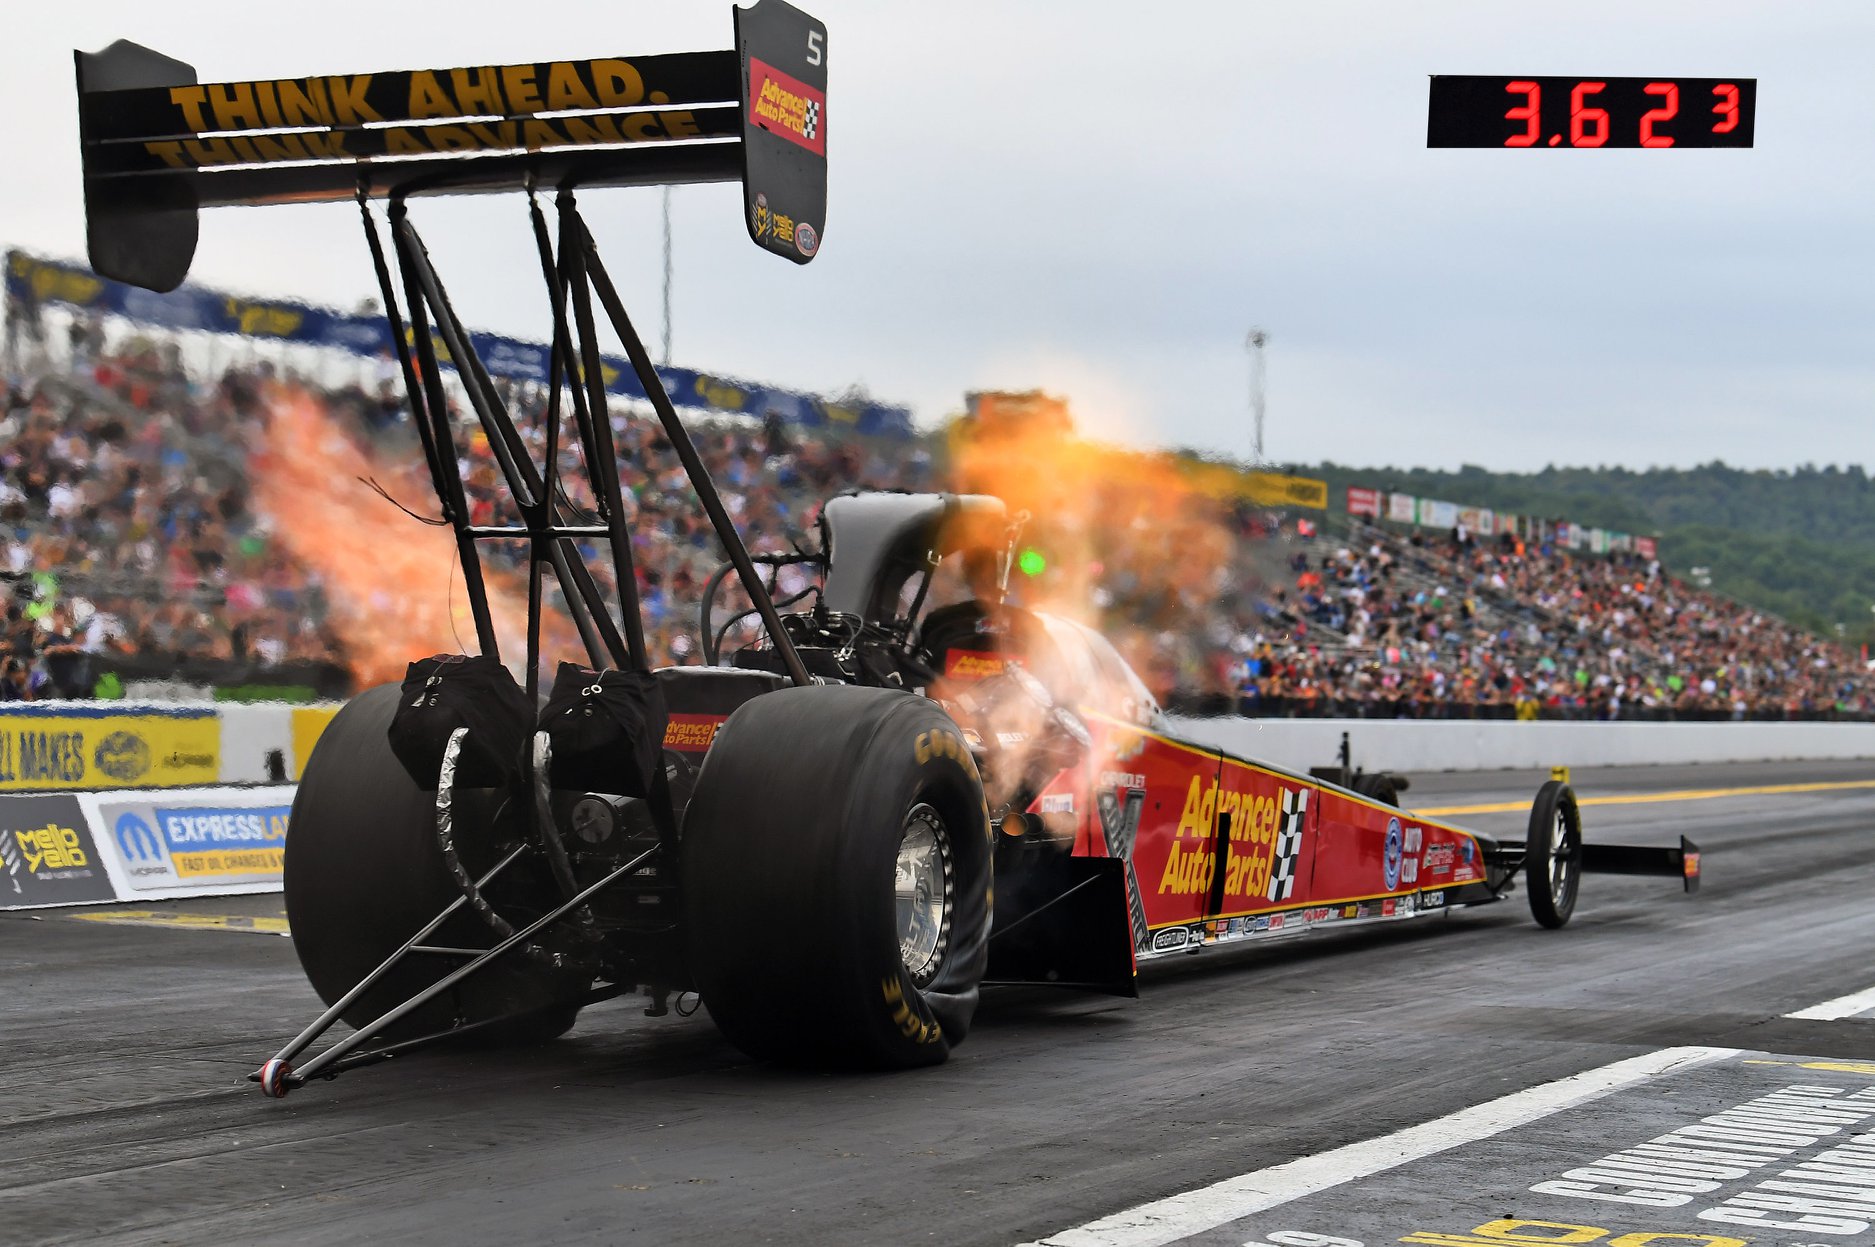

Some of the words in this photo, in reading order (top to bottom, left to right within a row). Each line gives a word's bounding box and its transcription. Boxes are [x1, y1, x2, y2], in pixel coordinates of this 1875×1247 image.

[806, 30, 823, 67] 5
[169, 75, 385, 133] THINK
[408, 59, 670, 119] AHEAD.
[755, 97, 778, 122] Auto
[777, 107, 802, 134] Parts
[760, 78, 804, 116] Advance
[1711, 84, 1740, 133] 3
[143, 130, 346, 169] THINK
[662, 734, 676, 744] to
[675, 734, 708, 745] Parts
[666, 721, 711, 735] dvance
[20, 731, 85, 781] MAKES
[167, 814, 290, 842] EXPRESSLA
[1175, 774, 1275, 845] Advance
[1157, 841, 1217, 895] Auto
[1528, 1093, 1875, 1207] COUNTDOWN
